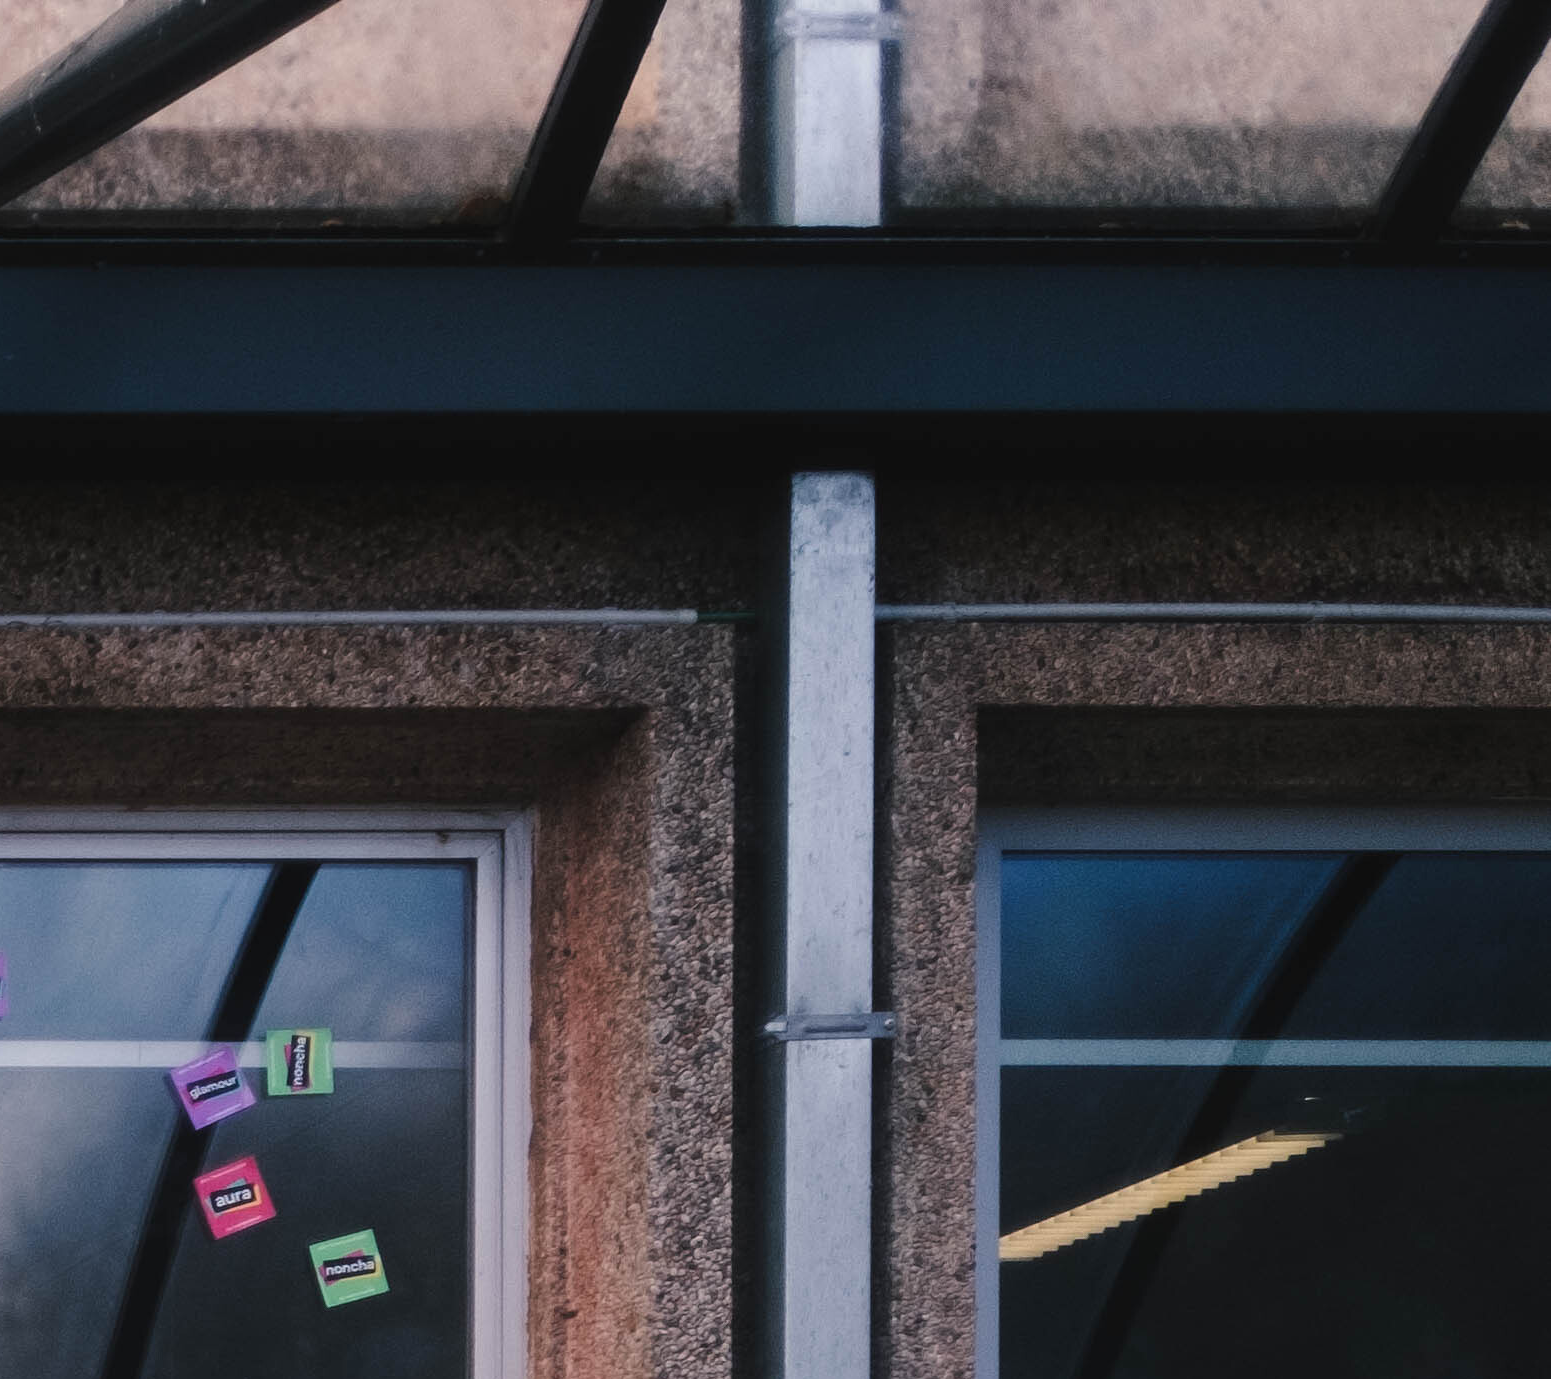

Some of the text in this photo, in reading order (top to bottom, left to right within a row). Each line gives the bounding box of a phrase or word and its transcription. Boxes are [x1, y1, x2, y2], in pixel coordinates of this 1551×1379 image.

[293, 1037, 307, 1085] noncha
[190, 1076, 236, 1100] glamour
[215, 1189, 252, 1207] aura
[326, 1254, 374, 1276] noncha
